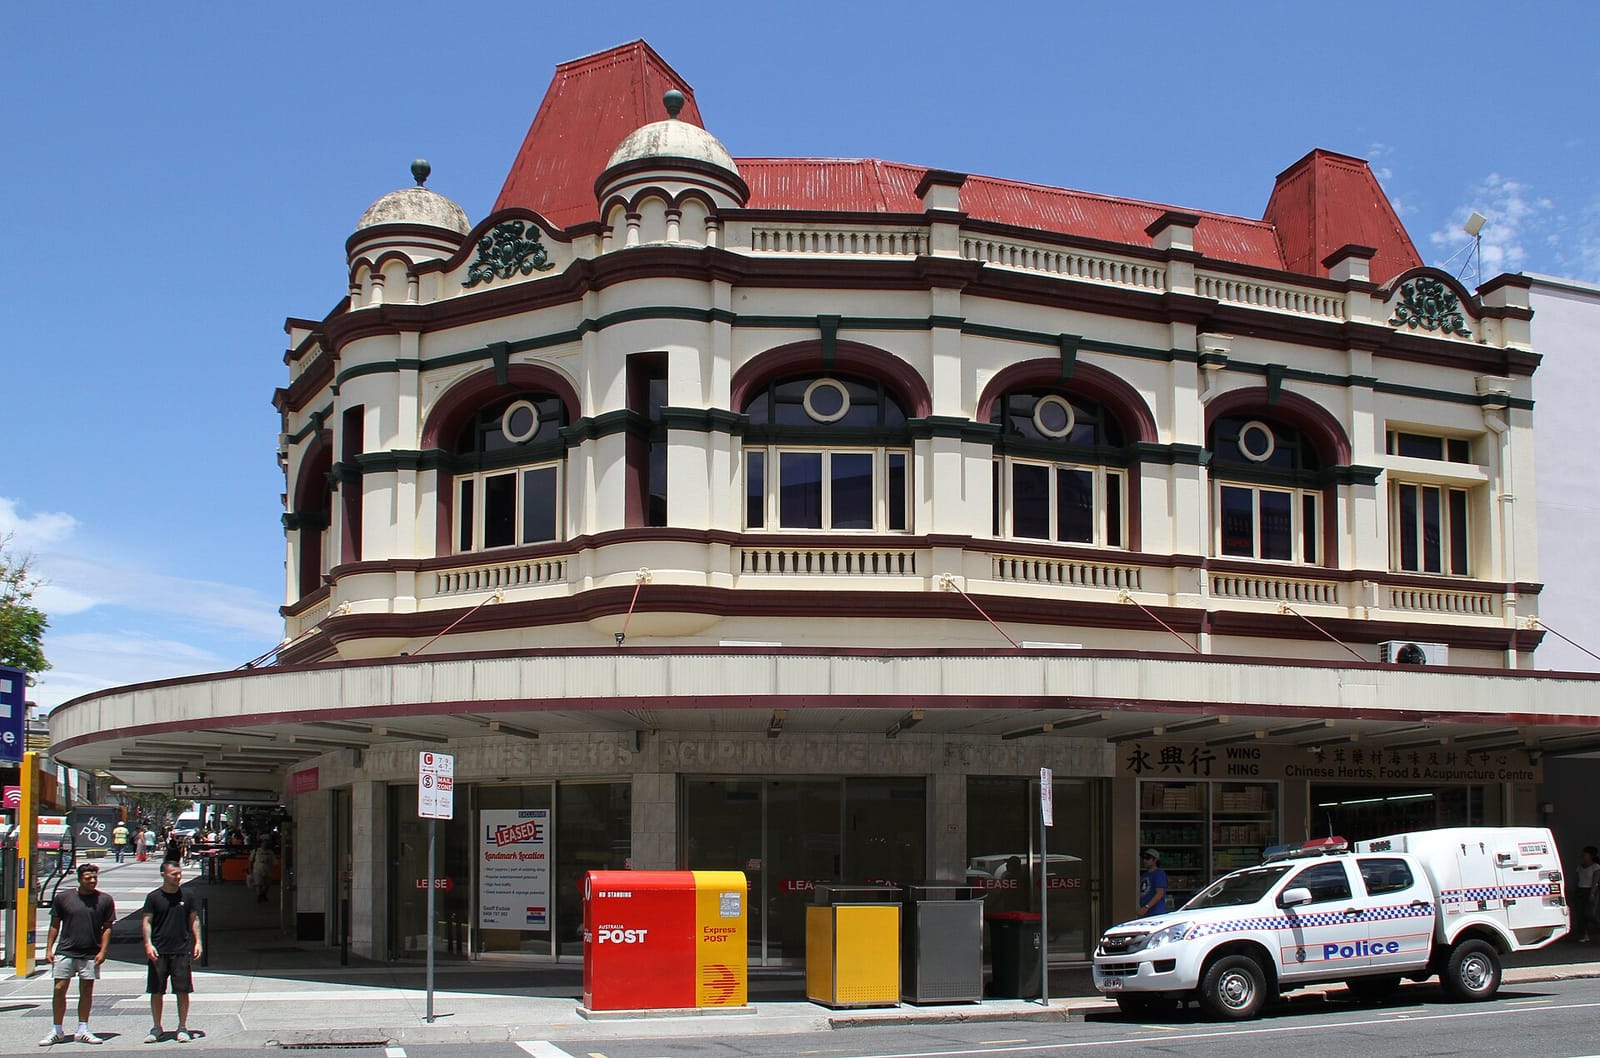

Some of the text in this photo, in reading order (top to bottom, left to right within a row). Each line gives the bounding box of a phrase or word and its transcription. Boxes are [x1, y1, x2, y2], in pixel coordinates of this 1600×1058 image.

[1126, 743, 1217, 776] 永興行
[1226, 747, 1261, 760] WING
[1227, 764, 1259, 776] HING
[1285, 765, 1334, 777] Chinese
[1379, 767, 1408, 778] Food
[1412, 767, 1421, 778] &
[1424, 768, 1495, 781] Acupuncture
[1498, 769, 1534, 780] Centre
[87, 816, 106, 832] the
[79, 827, 107, 846] POD
[496, 822, 535, 846] LEASED
[485, 851, 545, 861] Landmark Location
[416, 880, 447, 889] LESE
[598, 930, 648, 944] POST
[703, 926, 736, 934] Express
[703, 935, 728, 943] POST
[1323, 940, 1399, 960] Police
